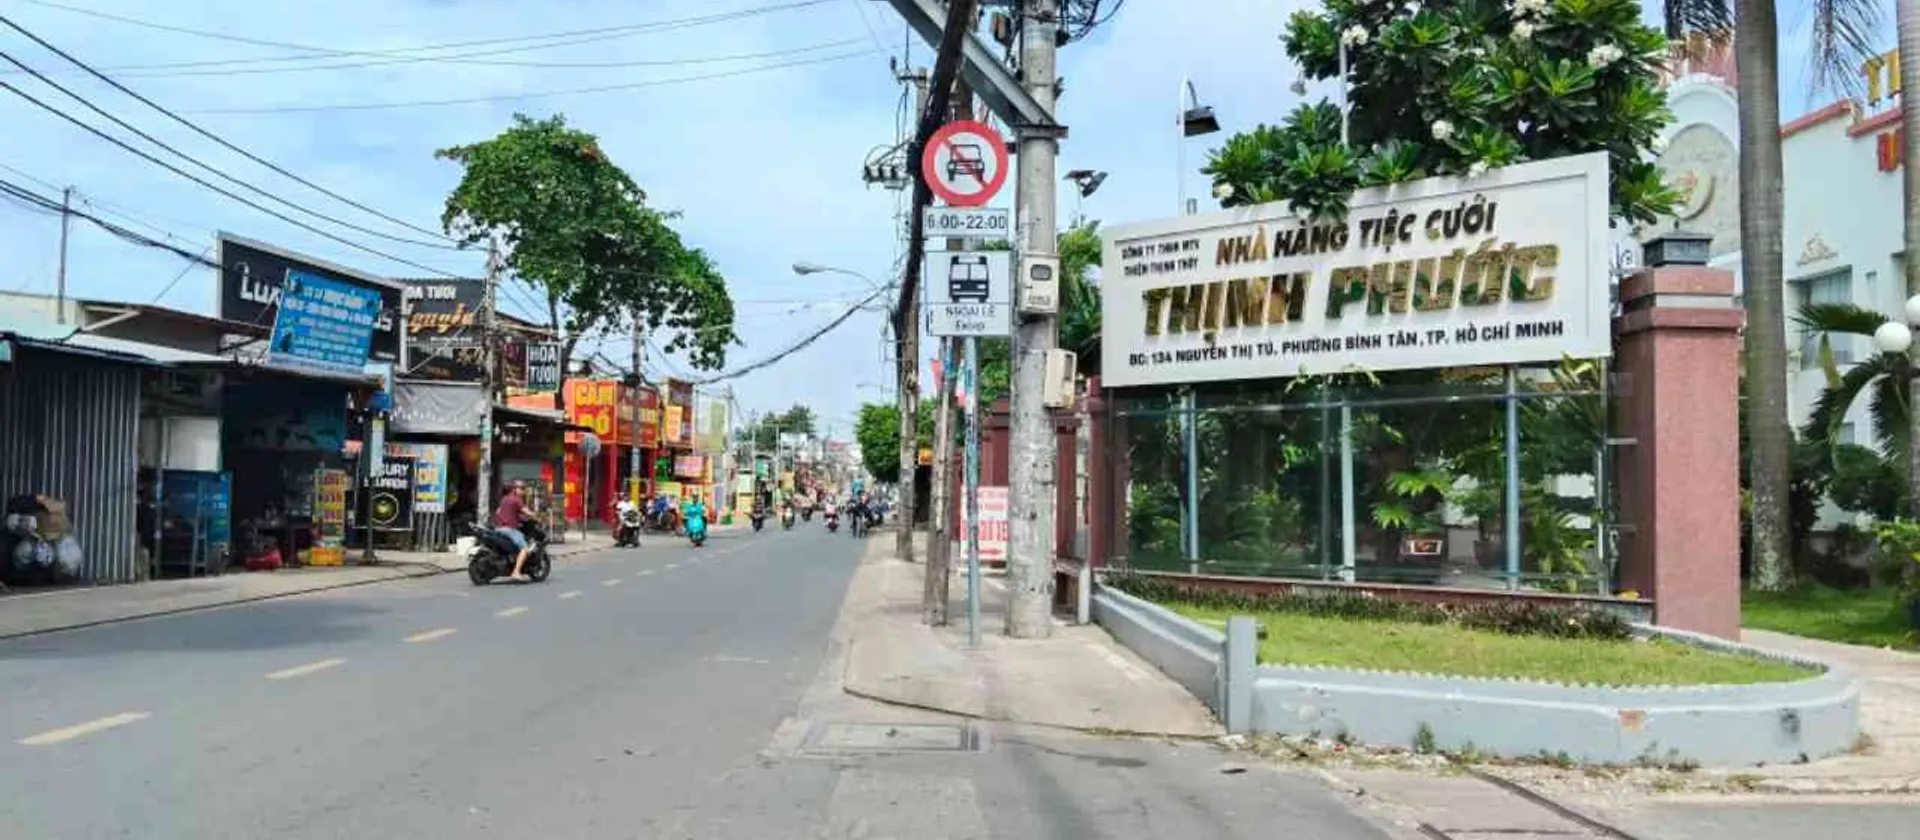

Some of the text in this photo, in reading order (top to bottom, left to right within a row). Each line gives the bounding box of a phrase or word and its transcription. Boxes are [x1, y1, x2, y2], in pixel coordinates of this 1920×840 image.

[1215, 223, 1269, 266] NHÀ
[1273, 218, 1349, 258] HÀNG
[1359, 207, 1417, 253] TIỆC
[1142, 237, 1561, 342] THỊNH PHƯỚC
[529, 346, 556, 362] HOA
[1175, 342, 1227, 363] NGUYỄN
[1231, 344, 1253, 360] THỊ
[1282, 335, 1342, 355] PHƯỜNG
[1455, 321, 1478, 343] HỒ
[1482, 321, 1511, 341] CHÍ
[1515, 320, 1563, 338] MINH
